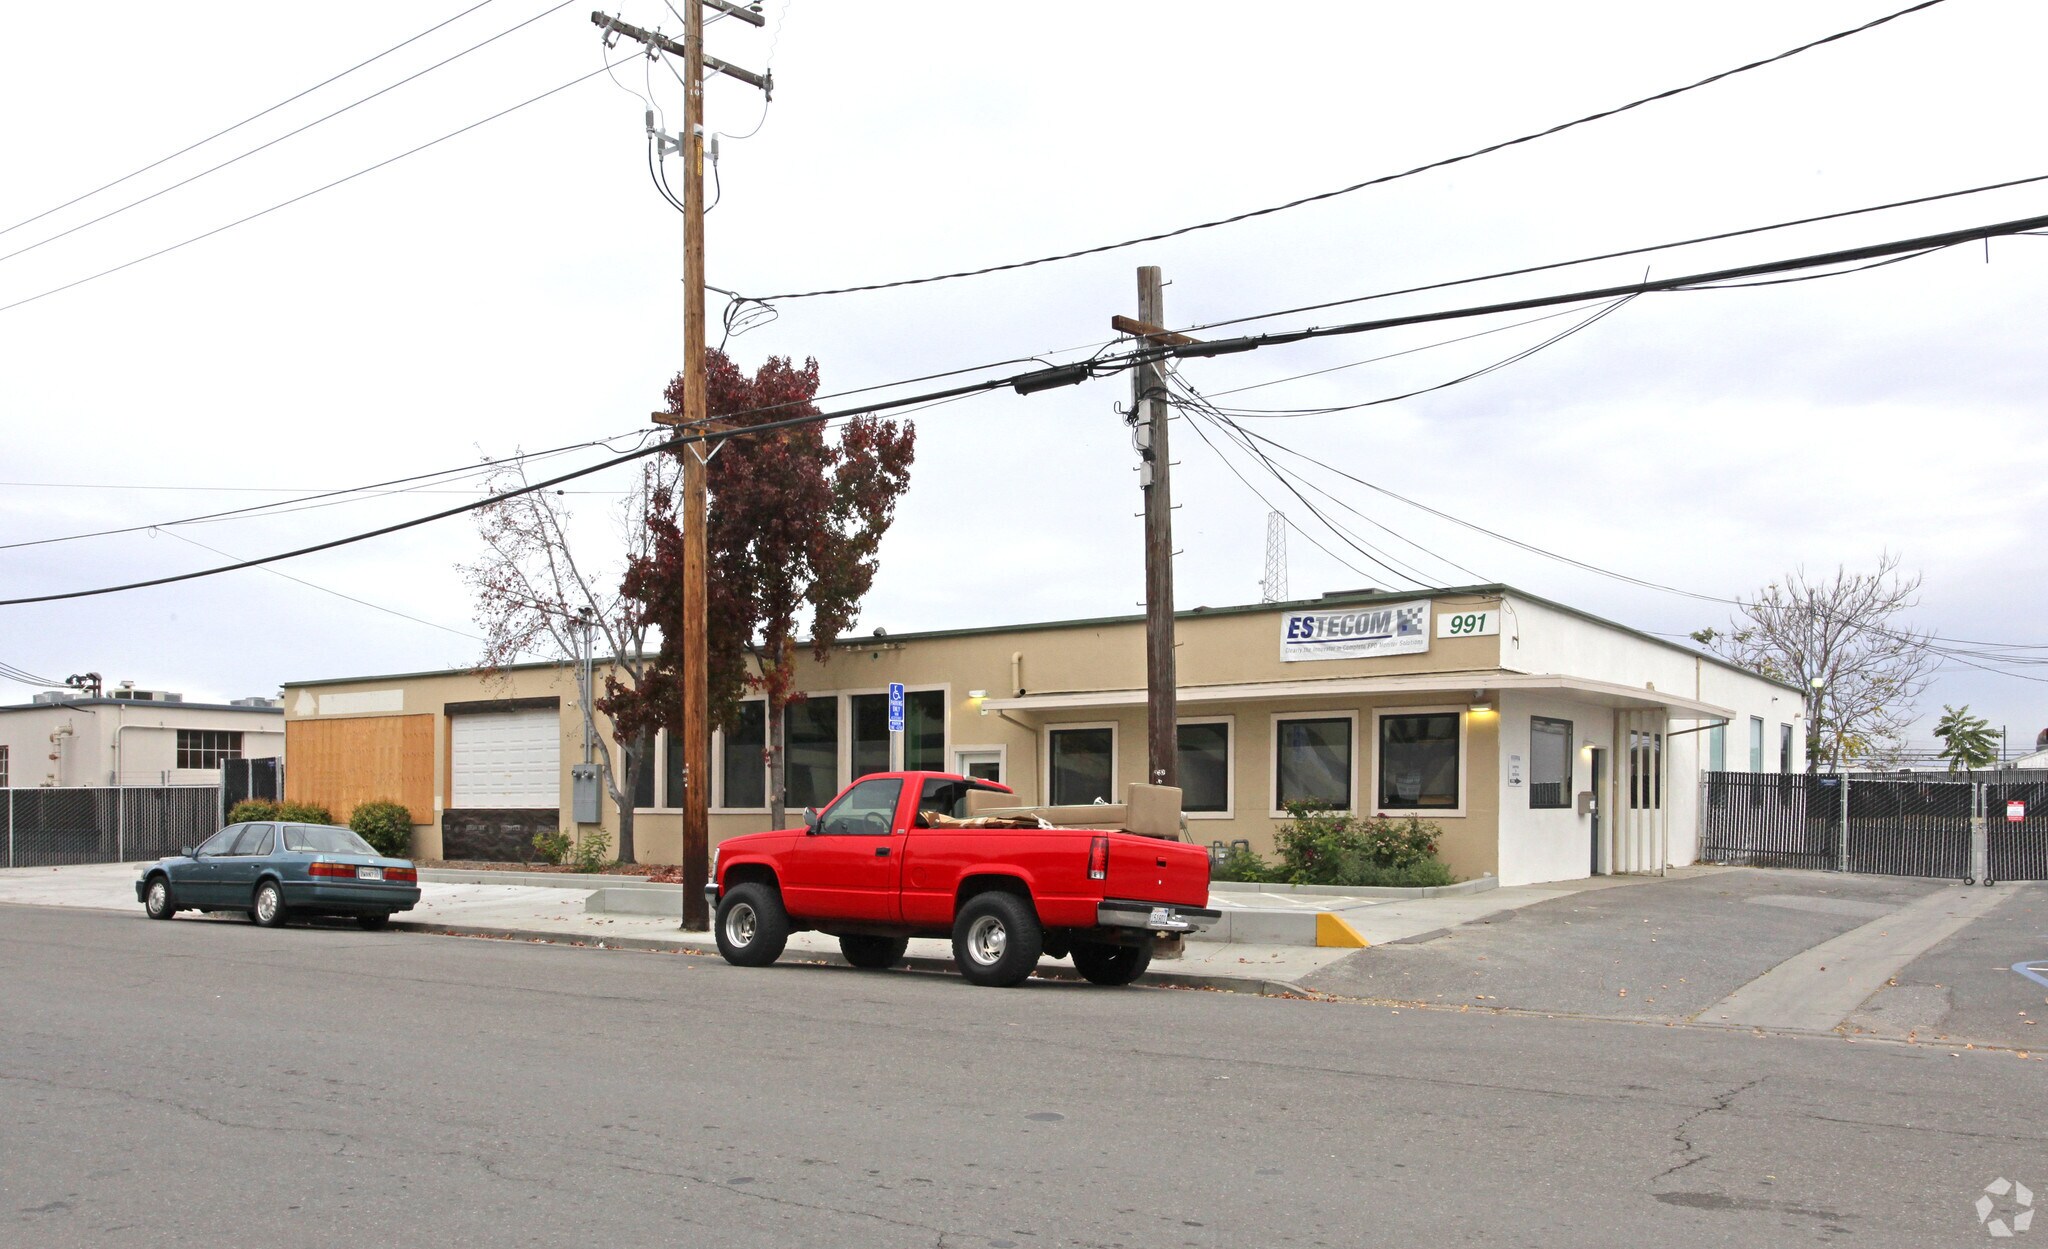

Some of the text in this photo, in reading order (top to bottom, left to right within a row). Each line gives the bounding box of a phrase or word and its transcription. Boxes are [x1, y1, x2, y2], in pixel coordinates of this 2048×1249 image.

[1287, 611, 1392, 639] ESTECOM
[1450, 613, 1486, 635] 991
[1342, 643, 1367, 651] Complete
[1399, 639, 1424, 647] Solutions
